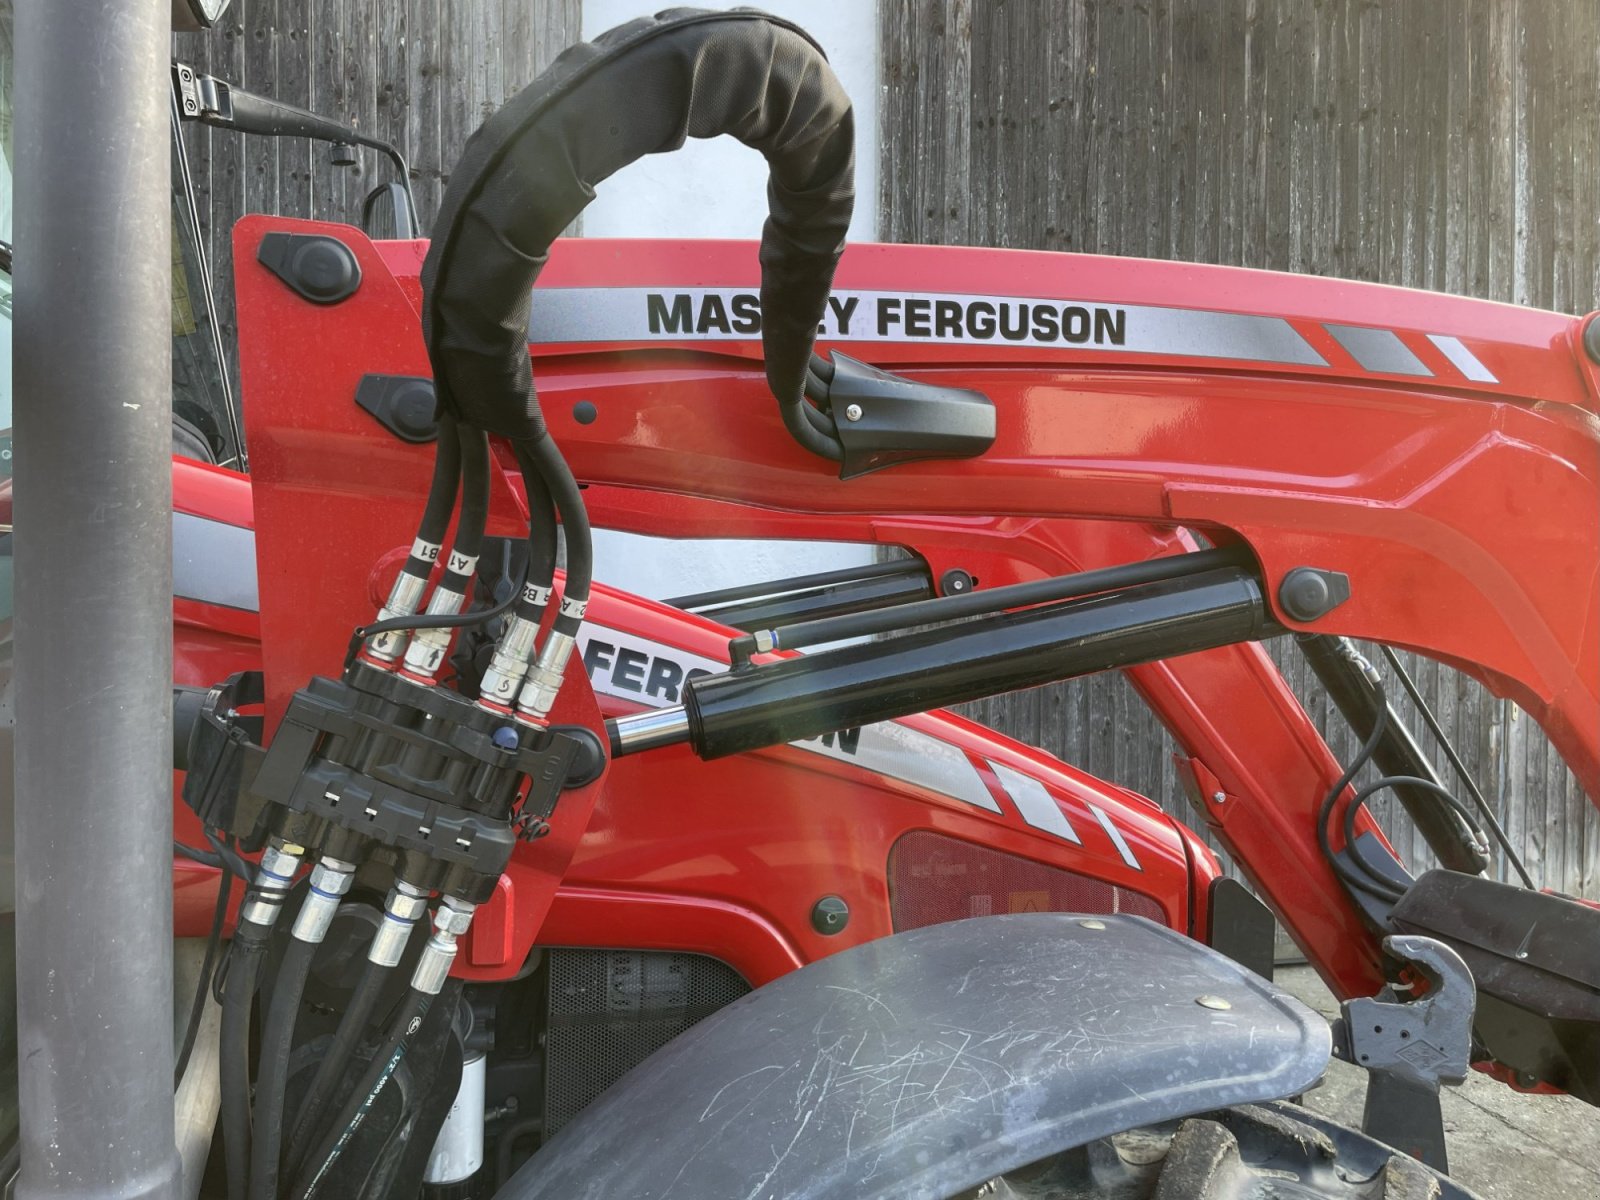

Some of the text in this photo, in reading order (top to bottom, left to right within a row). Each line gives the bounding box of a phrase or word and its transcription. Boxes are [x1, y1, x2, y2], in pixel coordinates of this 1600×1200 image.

[647, 293, 1126, 346] MASY FERGUSON
[421, 545, 438, 559] B1
[450, 555, 468, 571] A1
[373, 1075, 388, 1094] 4000
